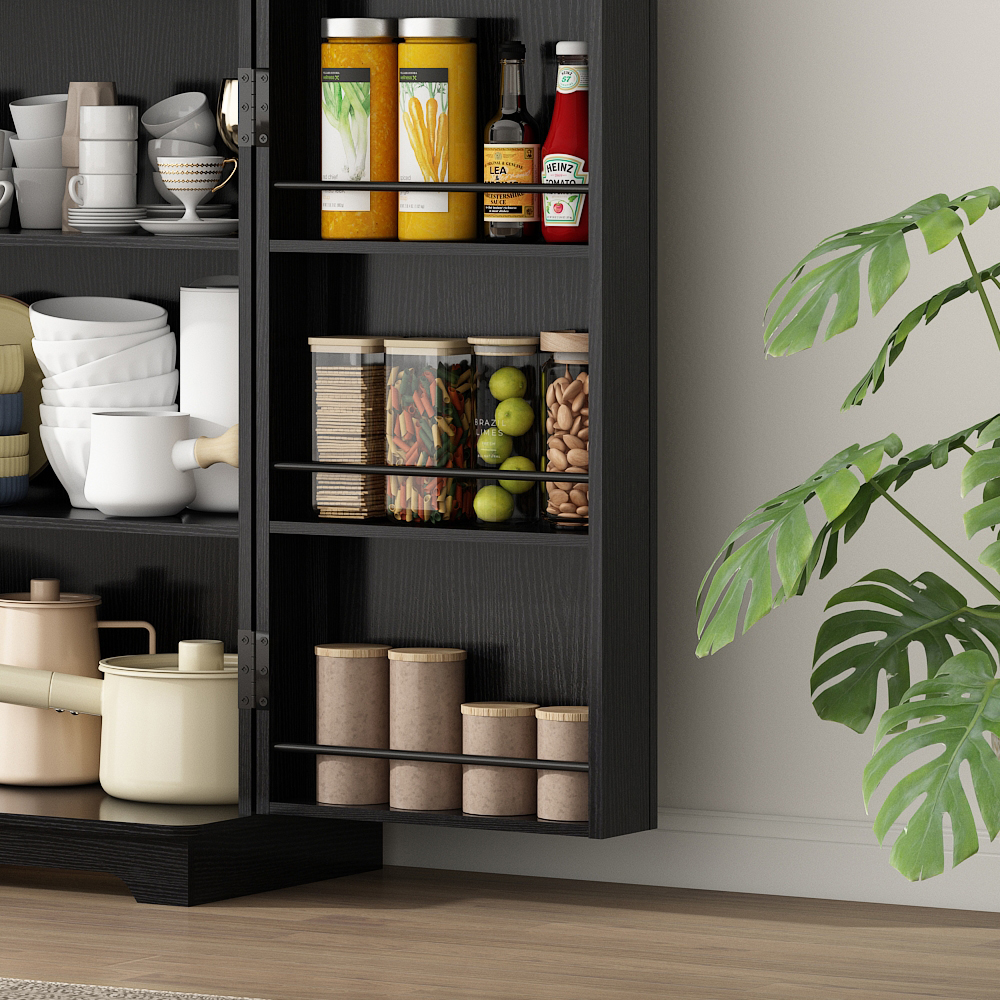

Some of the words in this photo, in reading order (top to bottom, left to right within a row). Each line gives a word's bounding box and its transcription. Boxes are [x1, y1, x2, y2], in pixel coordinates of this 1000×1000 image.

[489, 166, 507, 174] LEA
[546, 162, 574, 174] HEINZ
[475, 418, 507, 427] BRAZIL
[476, 429, 504, 437] LIMES
